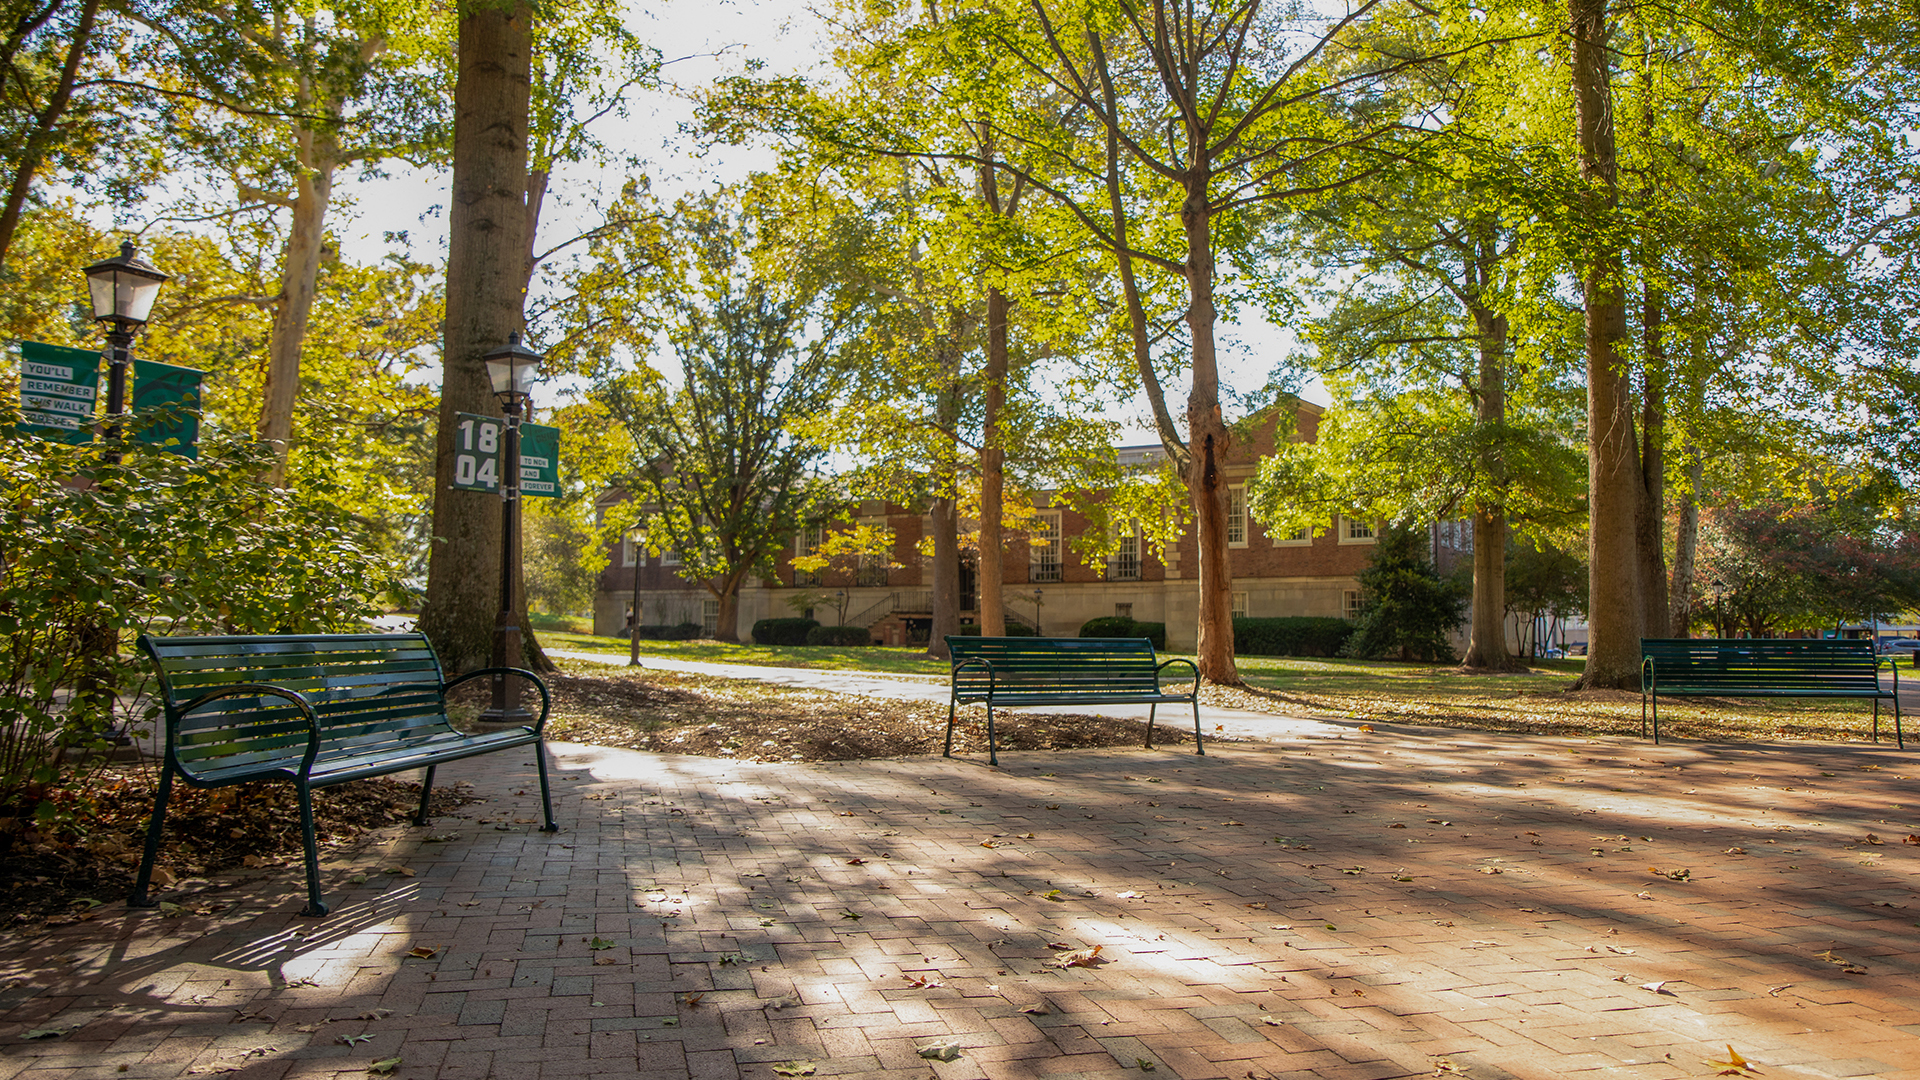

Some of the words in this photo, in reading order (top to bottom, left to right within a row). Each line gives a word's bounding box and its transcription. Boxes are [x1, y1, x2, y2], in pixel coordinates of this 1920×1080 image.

[28, 364, 69, 377] YOU'LL
[28, 380, 91, 397] REMEMBER
[54, 401, 87, 413] WALK
[461, 420, 499, 453] 18
[455, 454, 499, 488] 04
[524, 482, 552, 490] FOREVER
